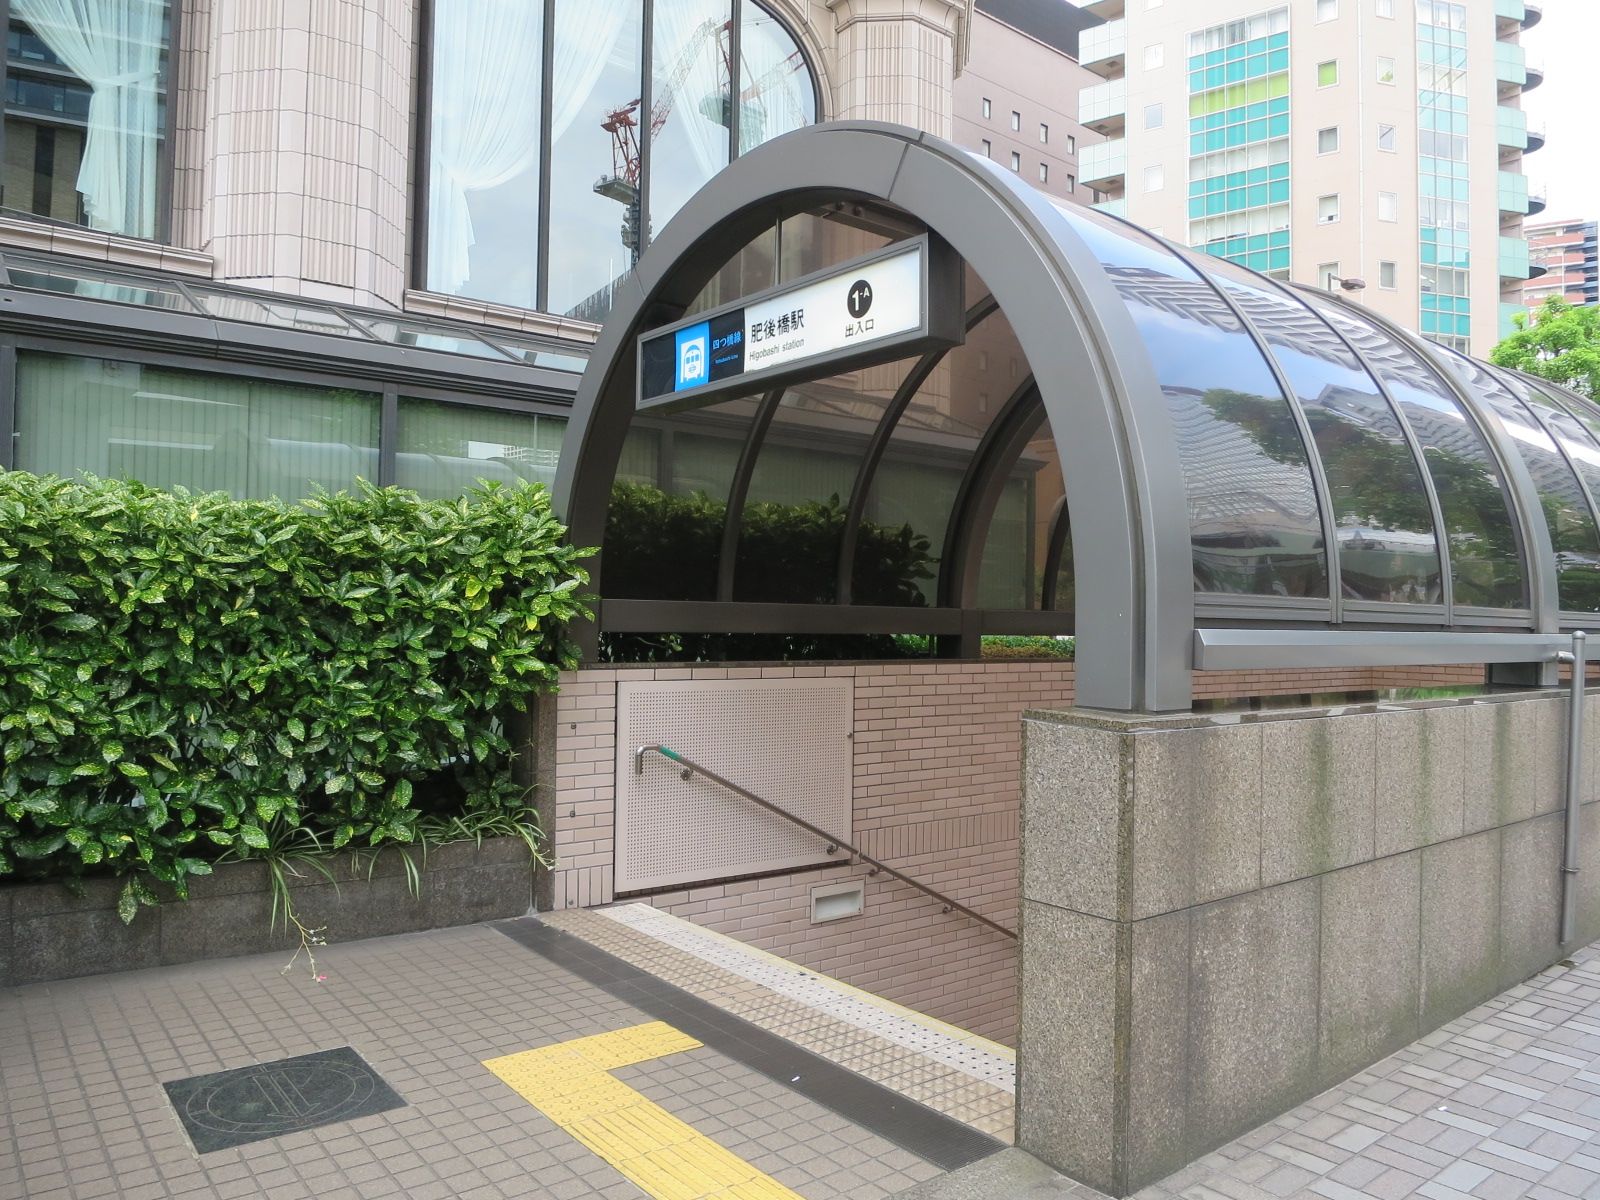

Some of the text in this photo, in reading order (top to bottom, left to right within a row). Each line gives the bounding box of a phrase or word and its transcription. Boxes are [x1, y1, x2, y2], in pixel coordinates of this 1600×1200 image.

[852, 286, 870, 311] 1-A
[750, 309, 804, 343] 肥後橋駅
[845, 319, 874, 338] 出入口
[749, 344, 780, 361] Higobashi
[782, 338, 804, 351] station
